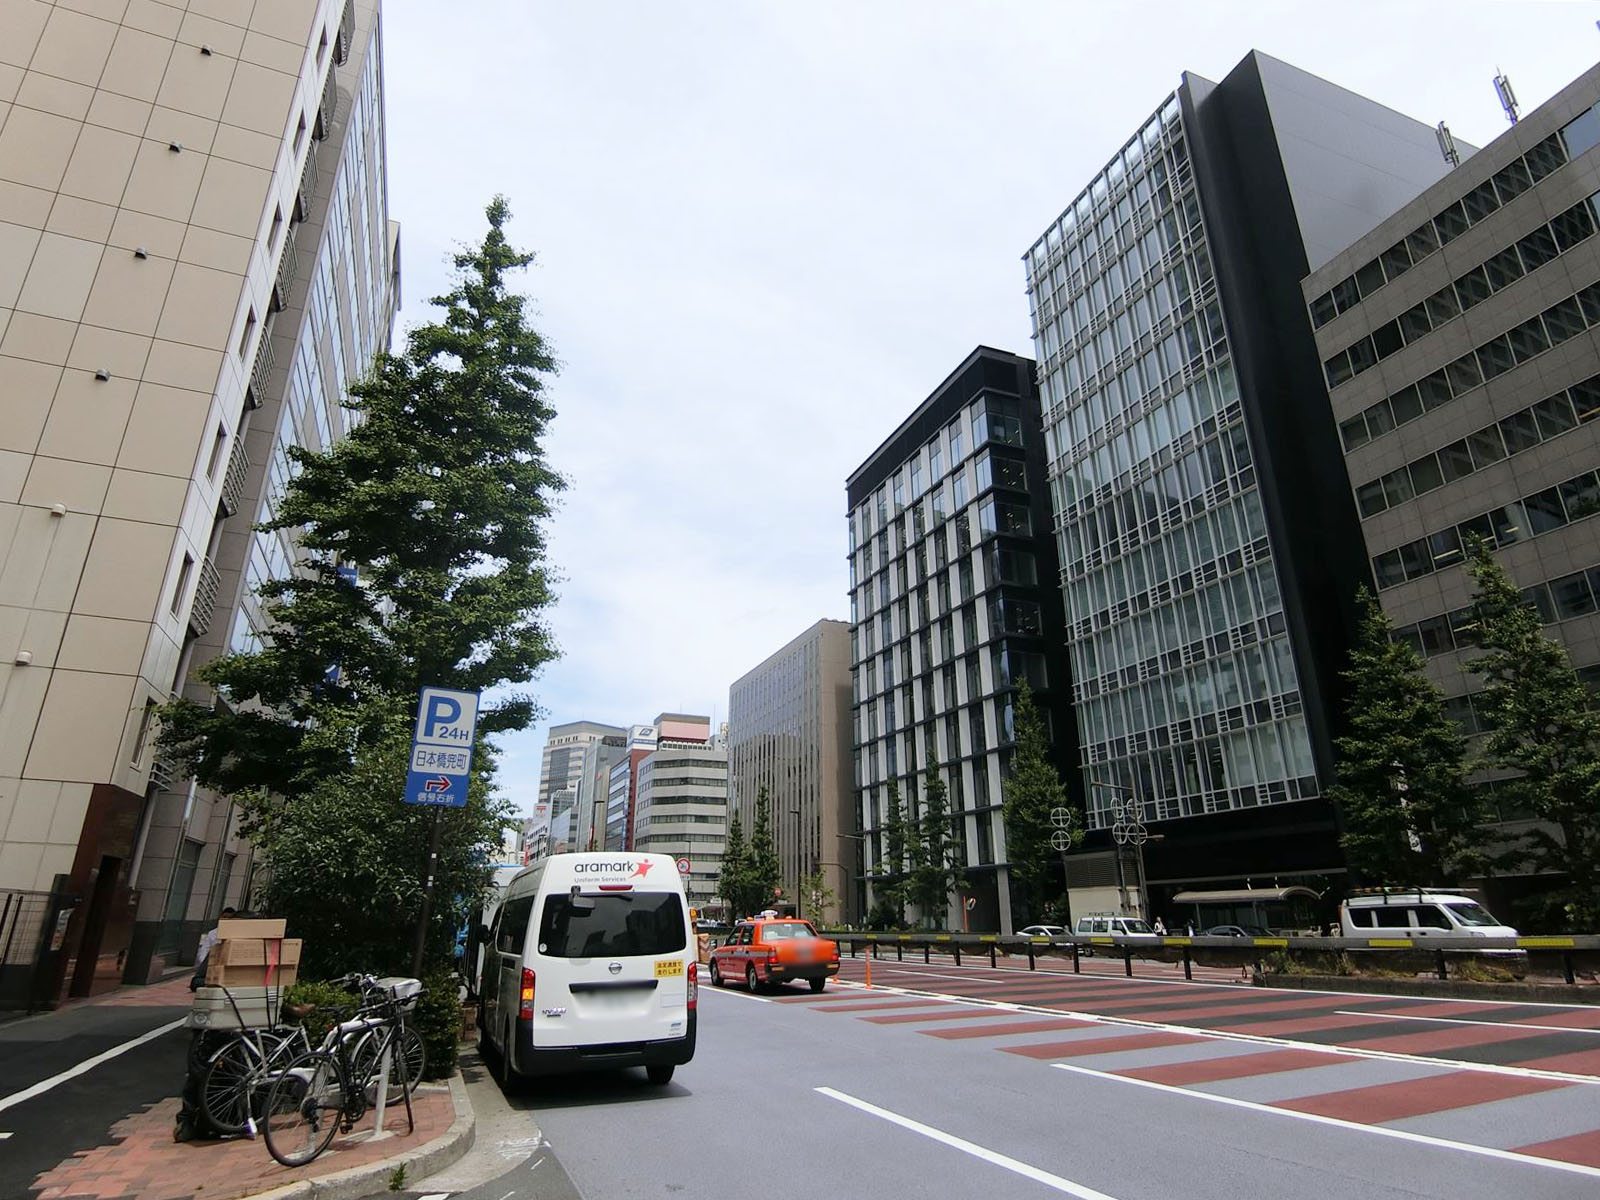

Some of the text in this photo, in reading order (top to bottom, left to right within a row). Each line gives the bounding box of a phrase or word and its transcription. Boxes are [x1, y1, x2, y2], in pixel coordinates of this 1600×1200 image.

[424, 695, 462, 737] P
[439, 725, 469, 741] 24H
[574, 860, 634, 873] aramark
